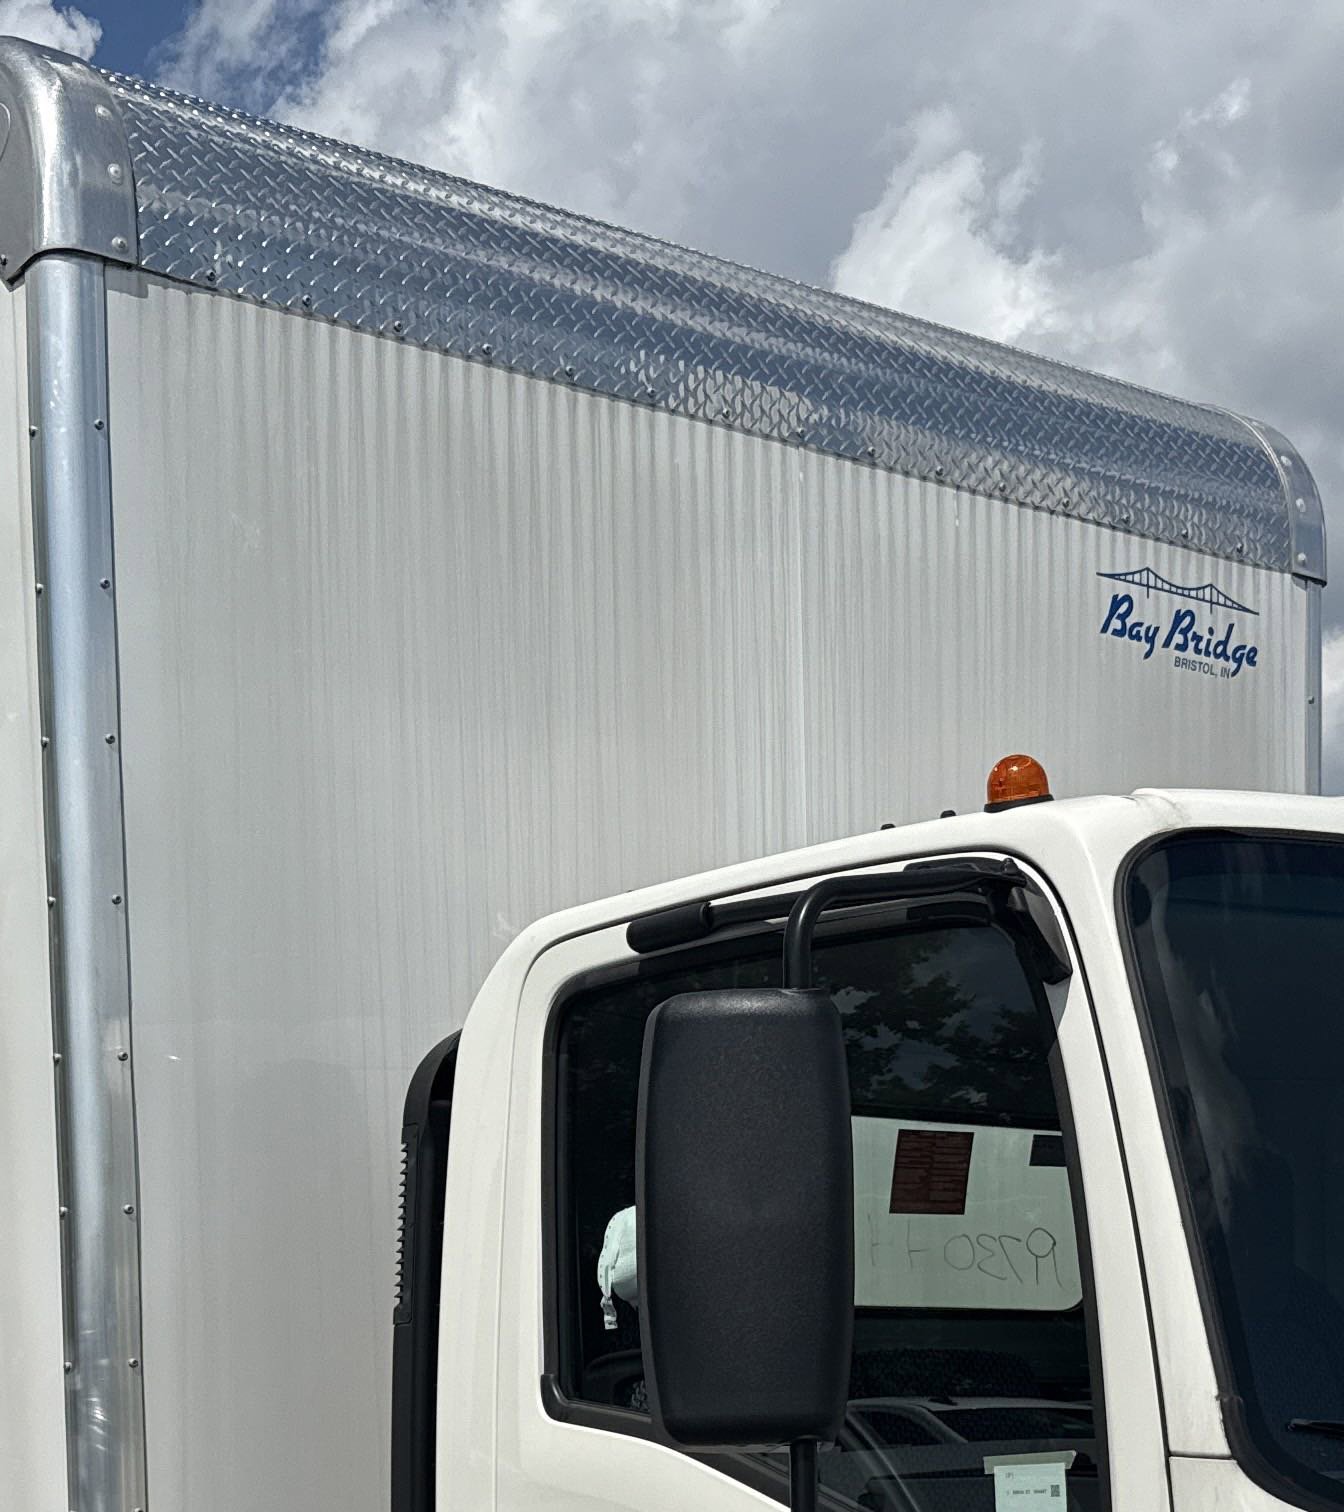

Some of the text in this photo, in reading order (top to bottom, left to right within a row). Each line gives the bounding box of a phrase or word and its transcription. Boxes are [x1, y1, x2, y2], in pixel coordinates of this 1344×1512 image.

[1100, 593, 1258, 678] Bay Bridge
[1174, 656, 1232, 680] BRISTOL, IN
